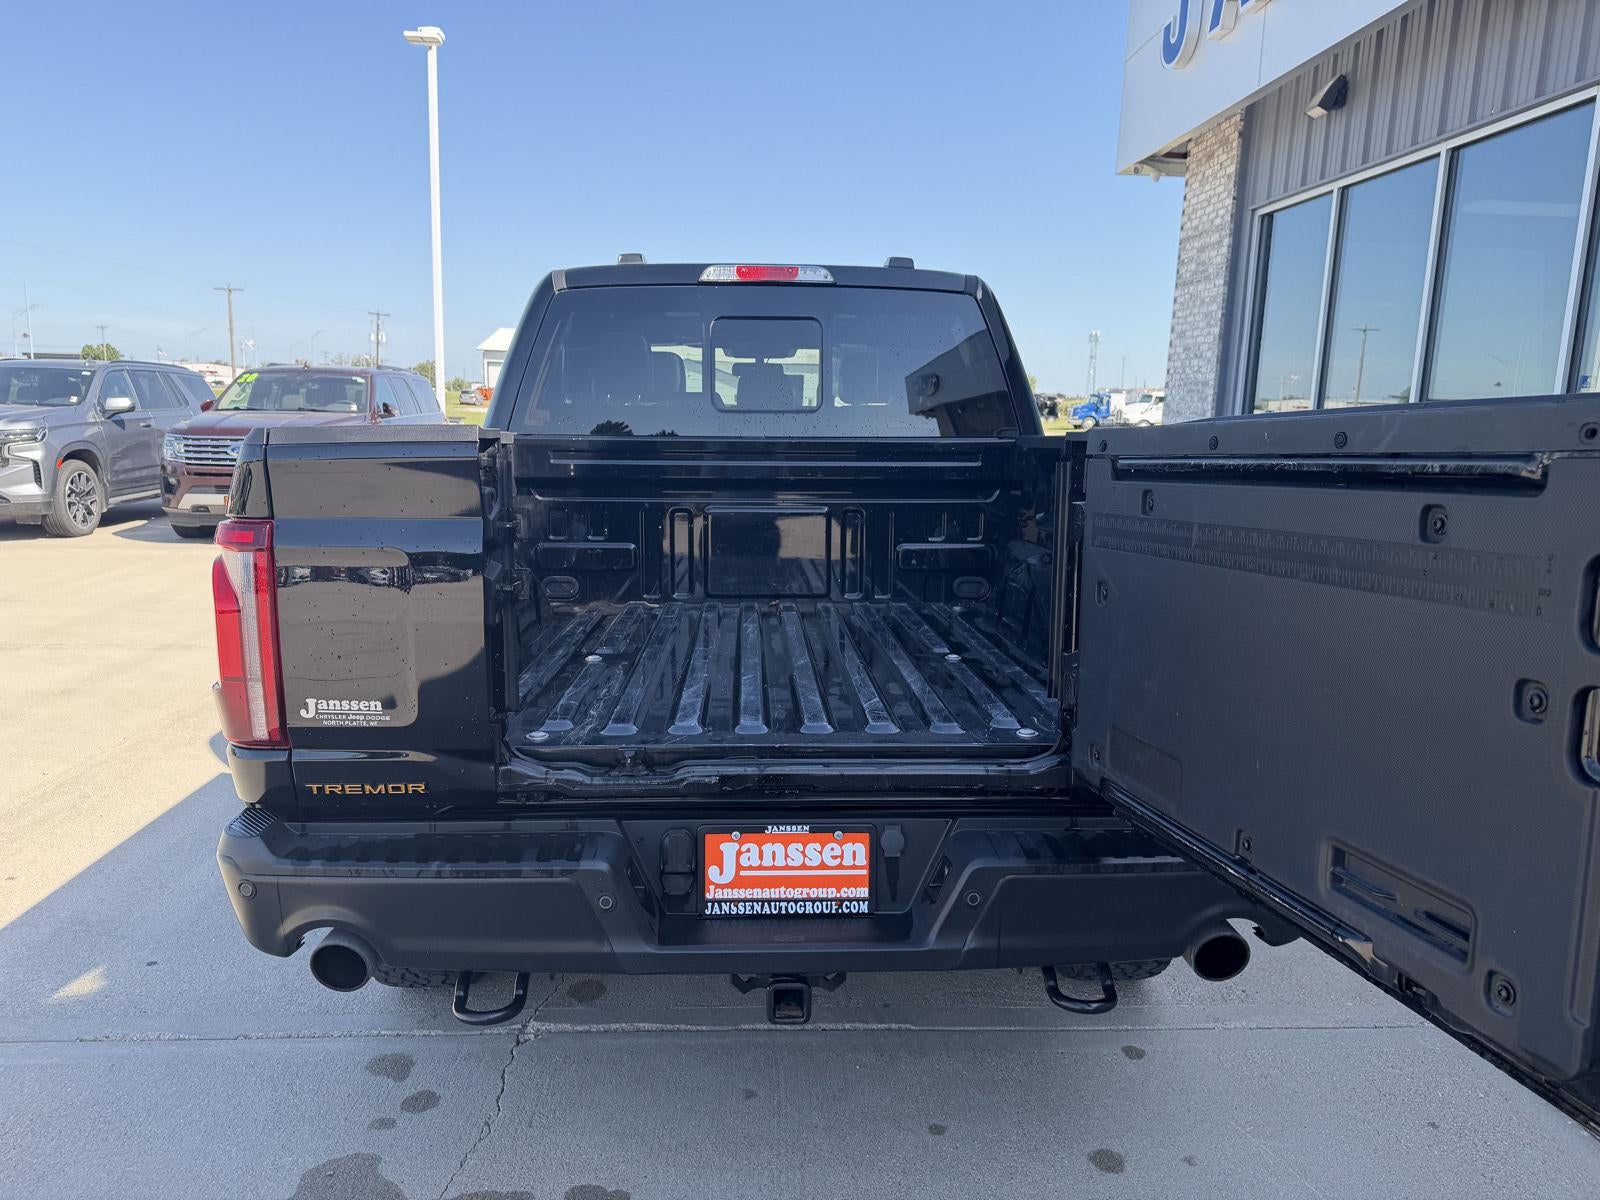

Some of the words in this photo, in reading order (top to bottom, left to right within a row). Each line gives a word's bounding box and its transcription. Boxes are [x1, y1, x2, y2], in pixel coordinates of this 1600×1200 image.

[300, 698, 382, 718] Janssen
[305, 783, 426, 795] TREMOR
[765, 825, 810, 834] JANSSEN
[707, 842, 867, 884] Janssen
[705, 885, 869, 899] Janssenautogroup.com
[704, 900, 869, 915] JANSSENAUTOGROUP.COM
